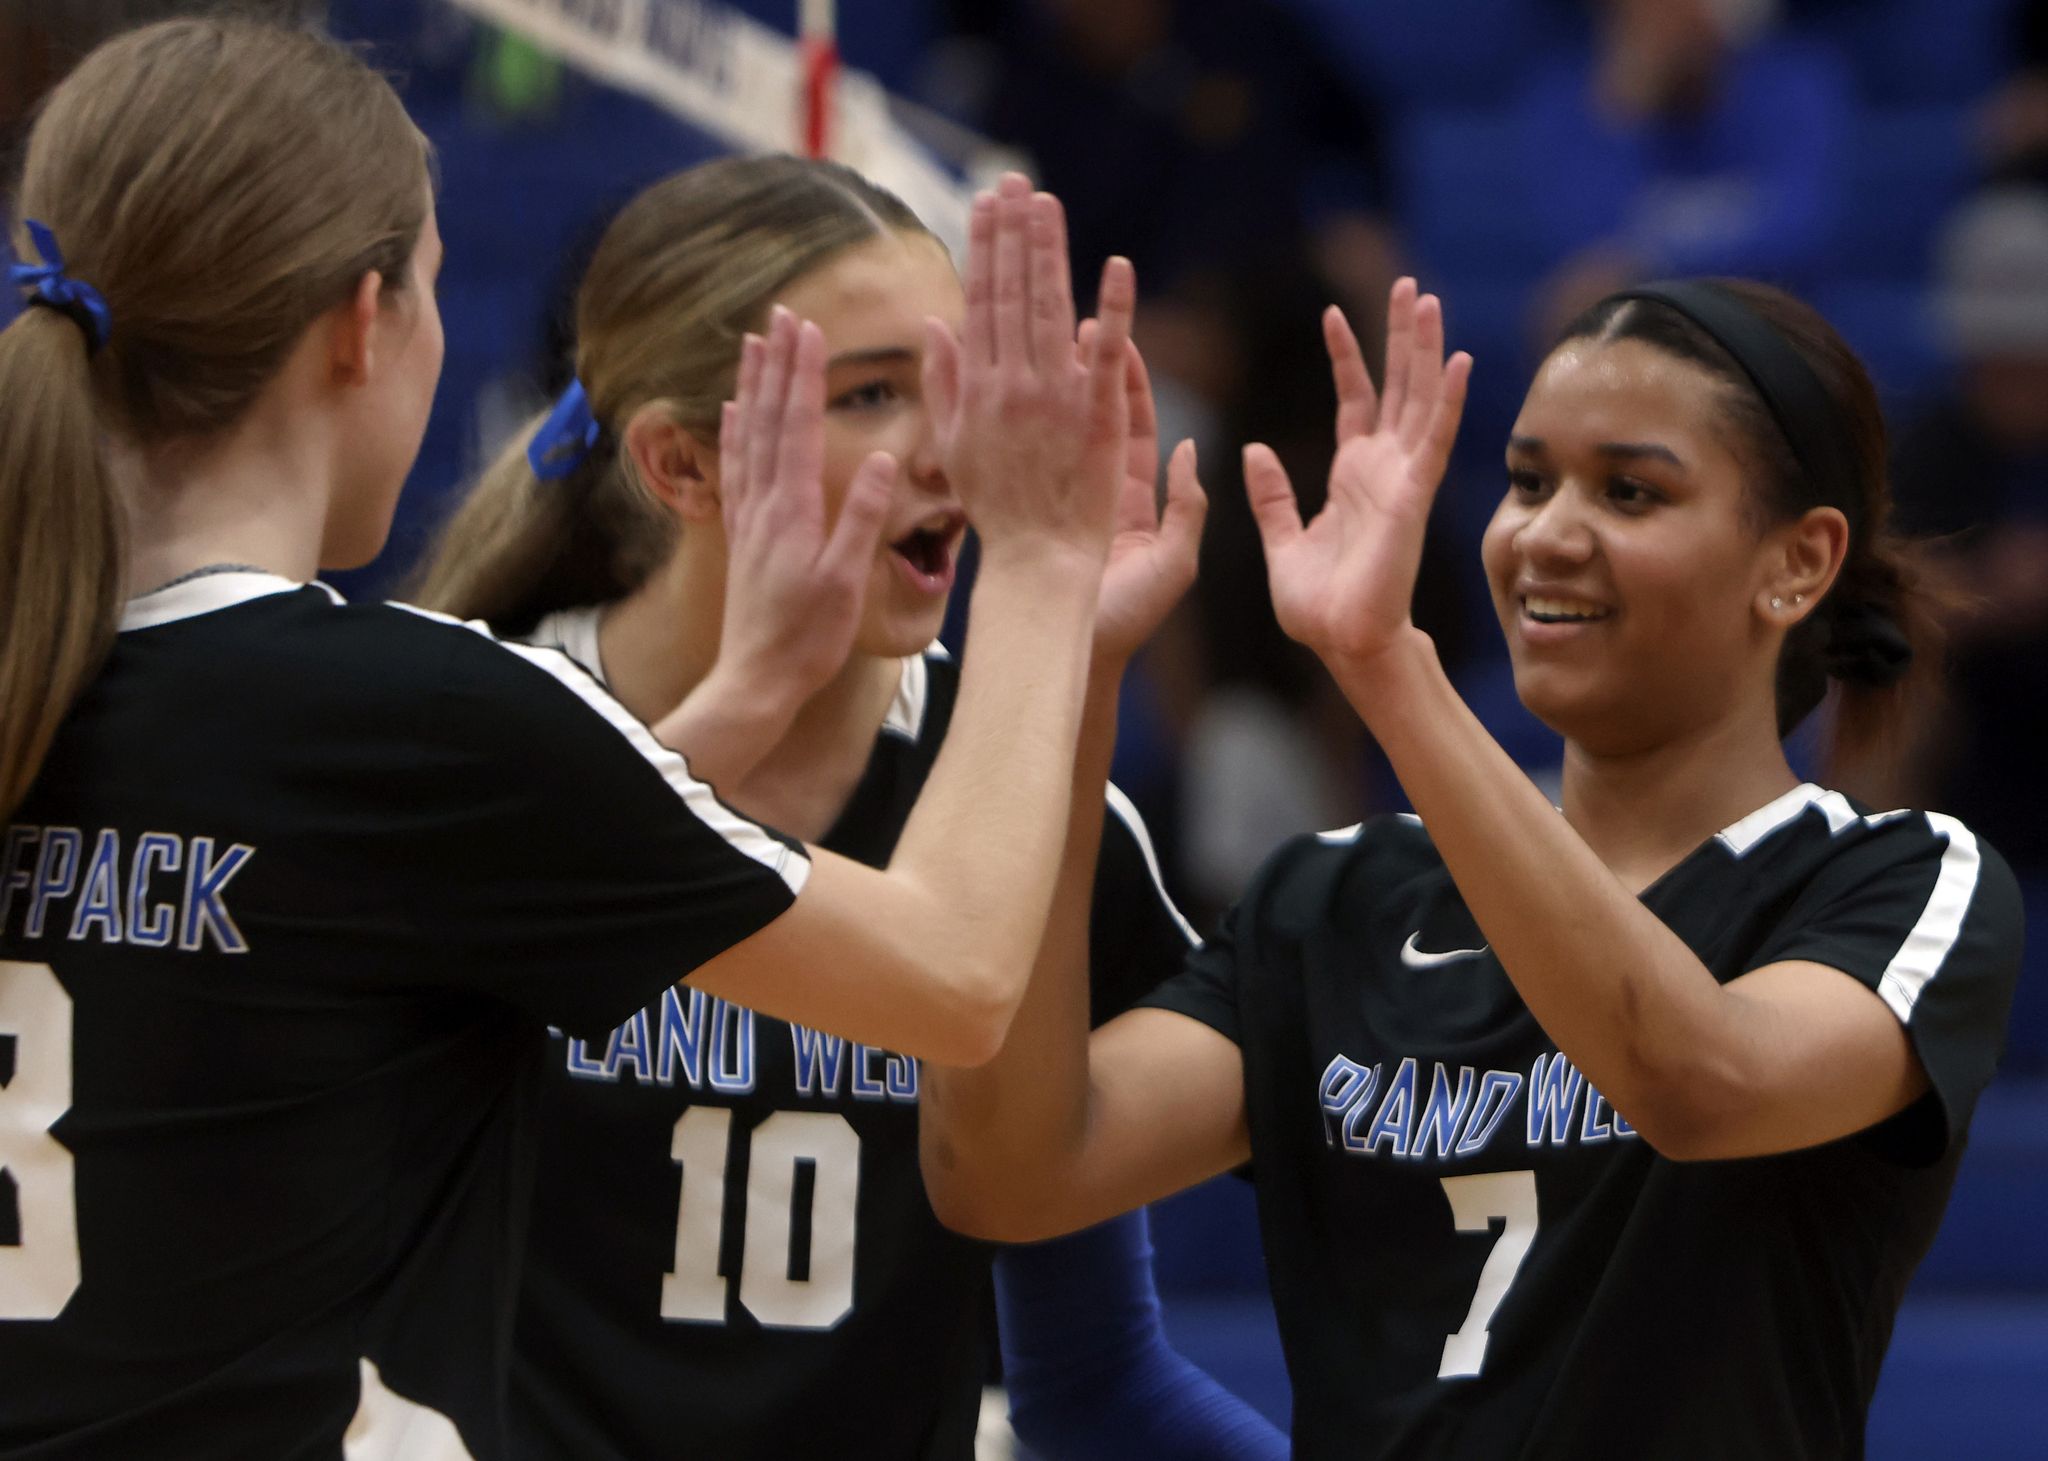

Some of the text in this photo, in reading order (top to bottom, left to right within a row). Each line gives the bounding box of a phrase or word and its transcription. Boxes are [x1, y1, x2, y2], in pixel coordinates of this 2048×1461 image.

[1318, 1053, 1523, 1157] PLANO
[660, 1104, 862, 1331] 10
[1436, 1169, 1539, 1379] 7
